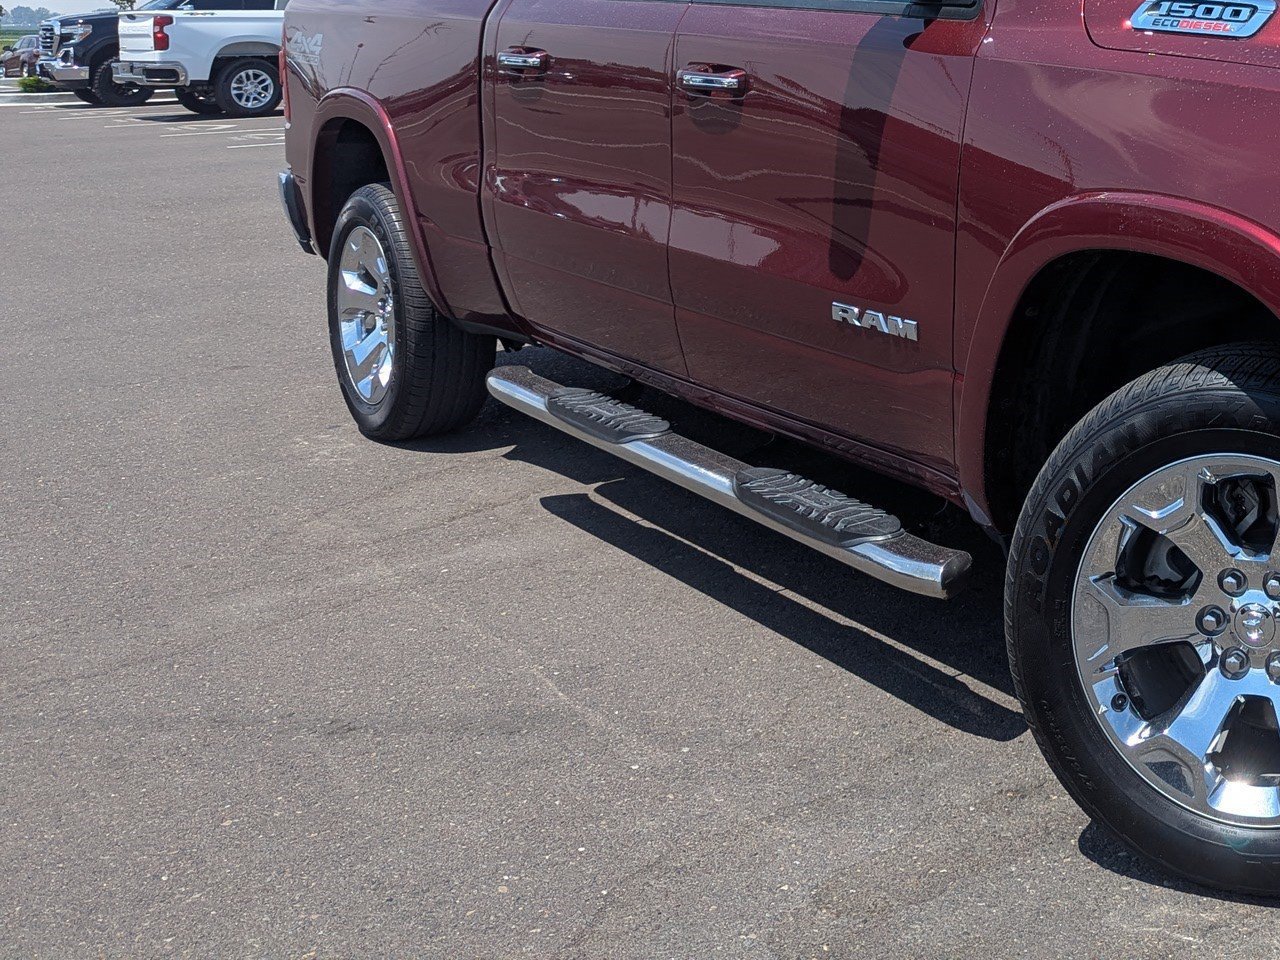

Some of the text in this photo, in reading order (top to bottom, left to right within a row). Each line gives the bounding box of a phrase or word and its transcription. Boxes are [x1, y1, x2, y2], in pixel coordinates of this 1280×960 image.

[1147, 0, 1253, 22] 1500
[1152, 18, 1232, 32] ECODIESEL
[832, 301, 918, 342] RAM
